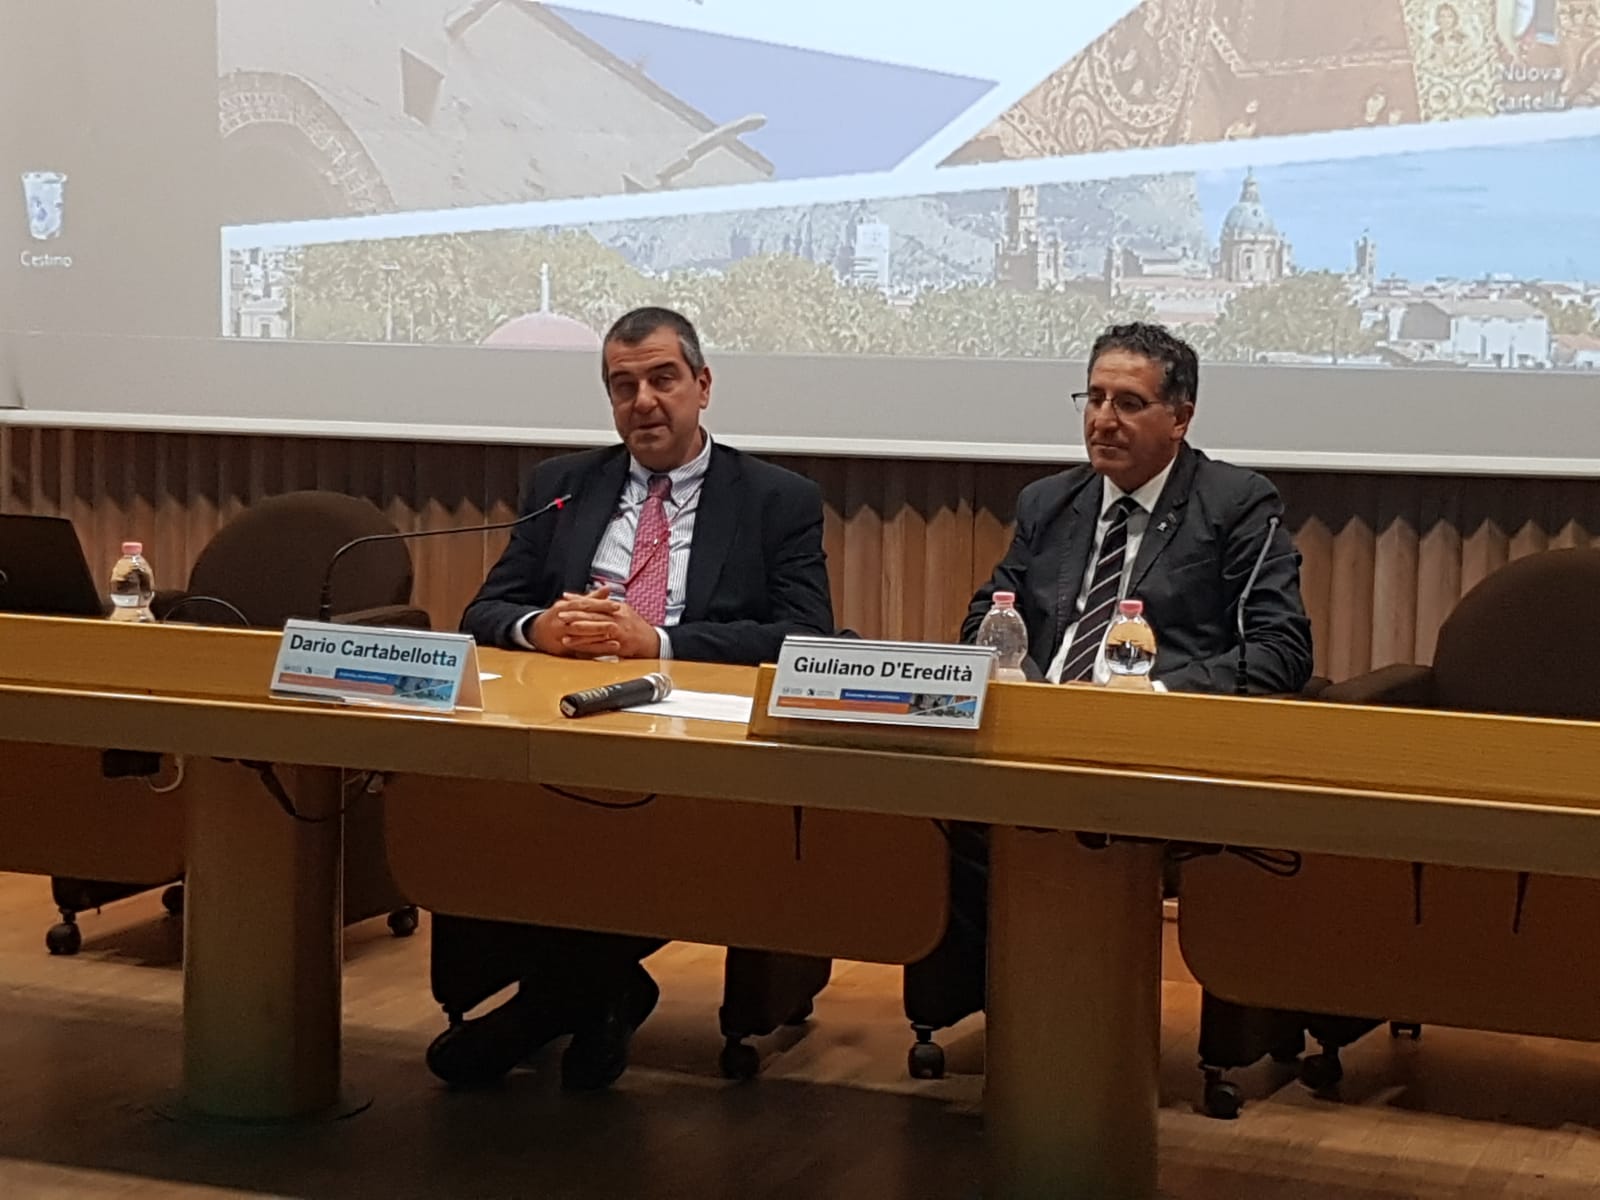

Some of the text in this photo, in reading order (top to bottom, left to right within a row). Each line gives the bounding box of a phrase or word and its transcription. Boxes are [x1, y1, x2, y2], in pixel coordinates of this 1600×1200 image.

[290, 634, 458, 667] Dario Cartabellotta
[793, 656, 973, 682] Giuliano D'Eredità
